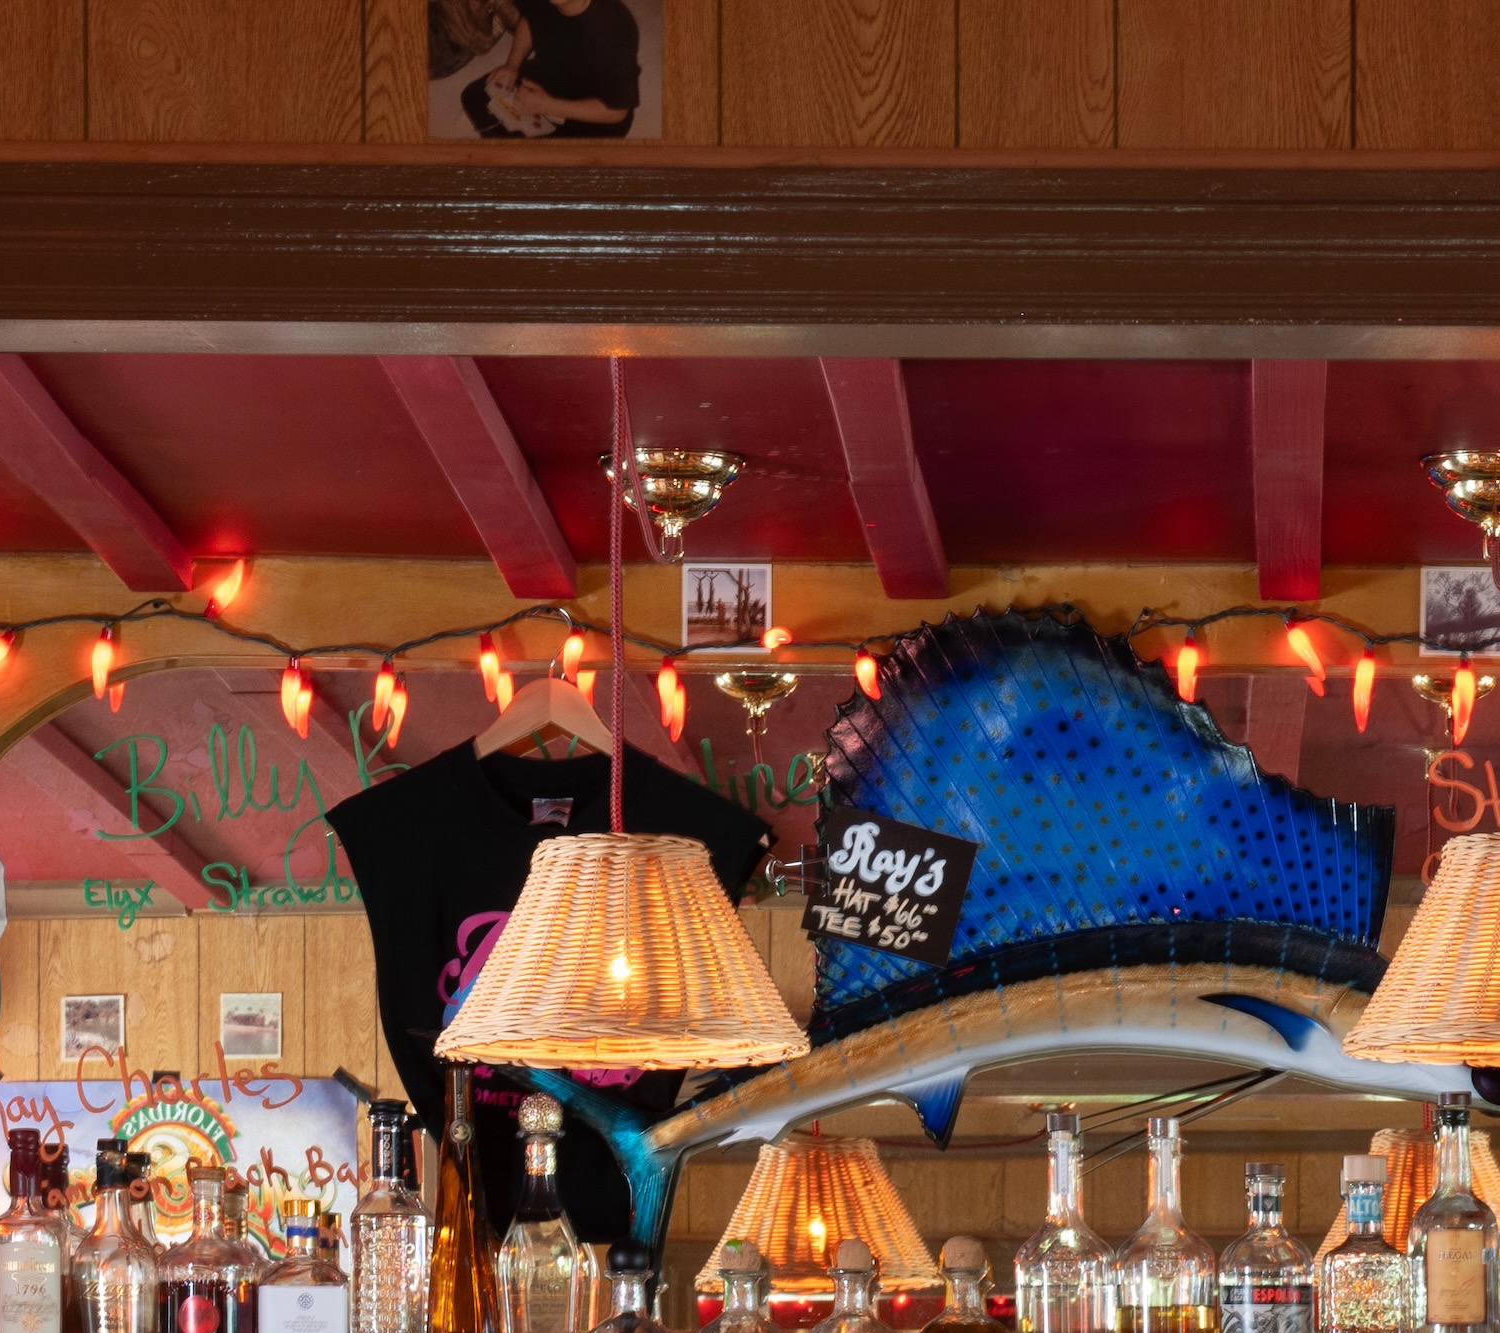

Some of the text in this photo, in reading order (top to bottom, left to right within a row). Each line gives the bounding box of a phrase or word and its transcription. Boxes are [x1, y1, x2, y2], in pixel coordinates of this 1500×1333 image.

[94, 724, 336, 902] Billy
[827, 821, 947, 897] Ray's
[199, 862, 363, 914] Strawb
[832, 876, 882, 915] HAT
[811, 904, 863, 939] TEE
[77, 1042, 304, 1115] Charles
[15, 1284, 47, 1296] 1796
